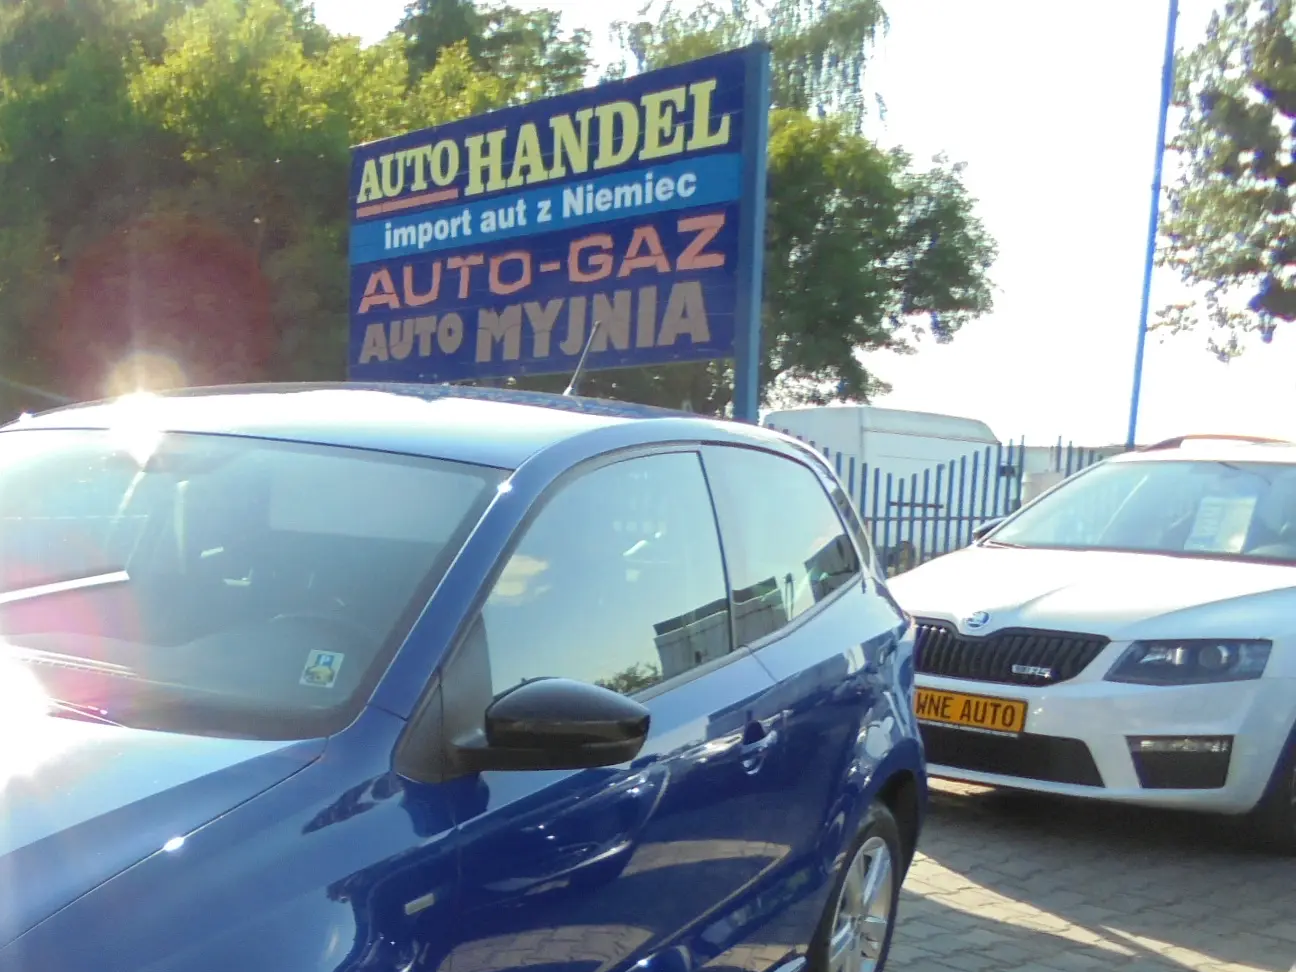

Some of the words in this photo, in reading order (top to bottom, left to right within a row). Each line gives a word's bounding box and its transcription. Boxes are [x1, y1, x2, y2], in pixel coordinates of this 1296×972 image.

[356, 139, 459, 204] AUTO
[465, 78, 730, 195] HANDEL
[384, 208, 472, 250] import
[480, 199, 526, 233] aut
[537, 201, 552, 222] z
[563, 171, 696, 218] Niemiec
[357, 214, 725, 314] AUTO-GAZ
[359, 312, 463, 364] AUTO
[475, 281, 710, 362] MYJNIA
[960, 699, 1016, 728] AUTO
